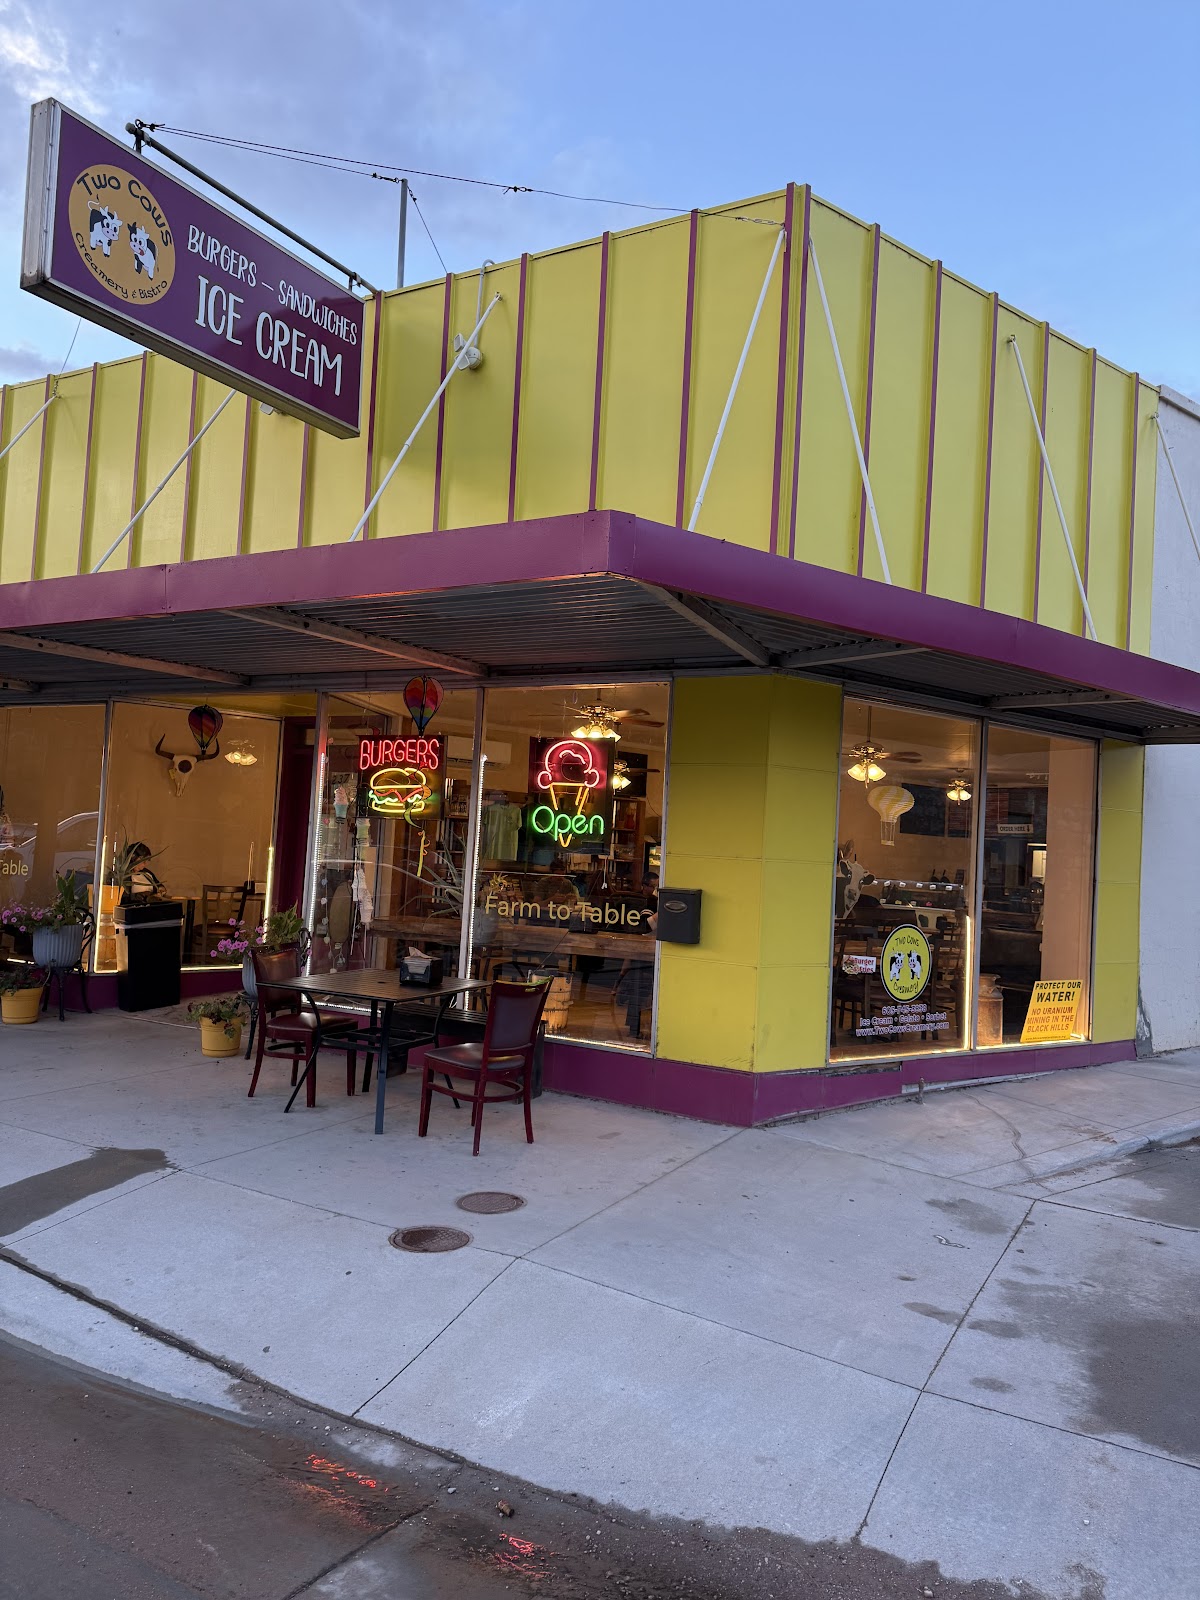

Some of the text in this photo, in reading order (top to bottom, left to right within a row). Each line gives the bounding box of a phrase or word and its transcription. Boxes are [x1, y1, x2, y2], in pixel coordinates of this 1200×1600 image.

[75, 231, 129, 300] Creamery
[138, 279, 169, 300] Bistro
[187, 224, 258, 288] BURGERS
[278, 279, 358, 346] SANDWICHES
[194, 275, 343, 397] ICE CREAM
[360, 738, 440, 771] BURGERS
[531, 805, 604, 841] Open
[485, 895, 641, 927] Farm to Table
[1035, 981, 1082, 990] PROTECT OUR
[1036, 991, 1075, 1003] WATER!
[860, 1017, 871, 1026] Ice
[872, 1015, 894, 1025] Cream
[1027, 1016, 1050, 1024] MINING
[1052, 1015, 1059, 1023] IN
[1031, 1007, 1073, 1016] NO URANIUM
[1027, 1025, 1048, 1033] BLACK
